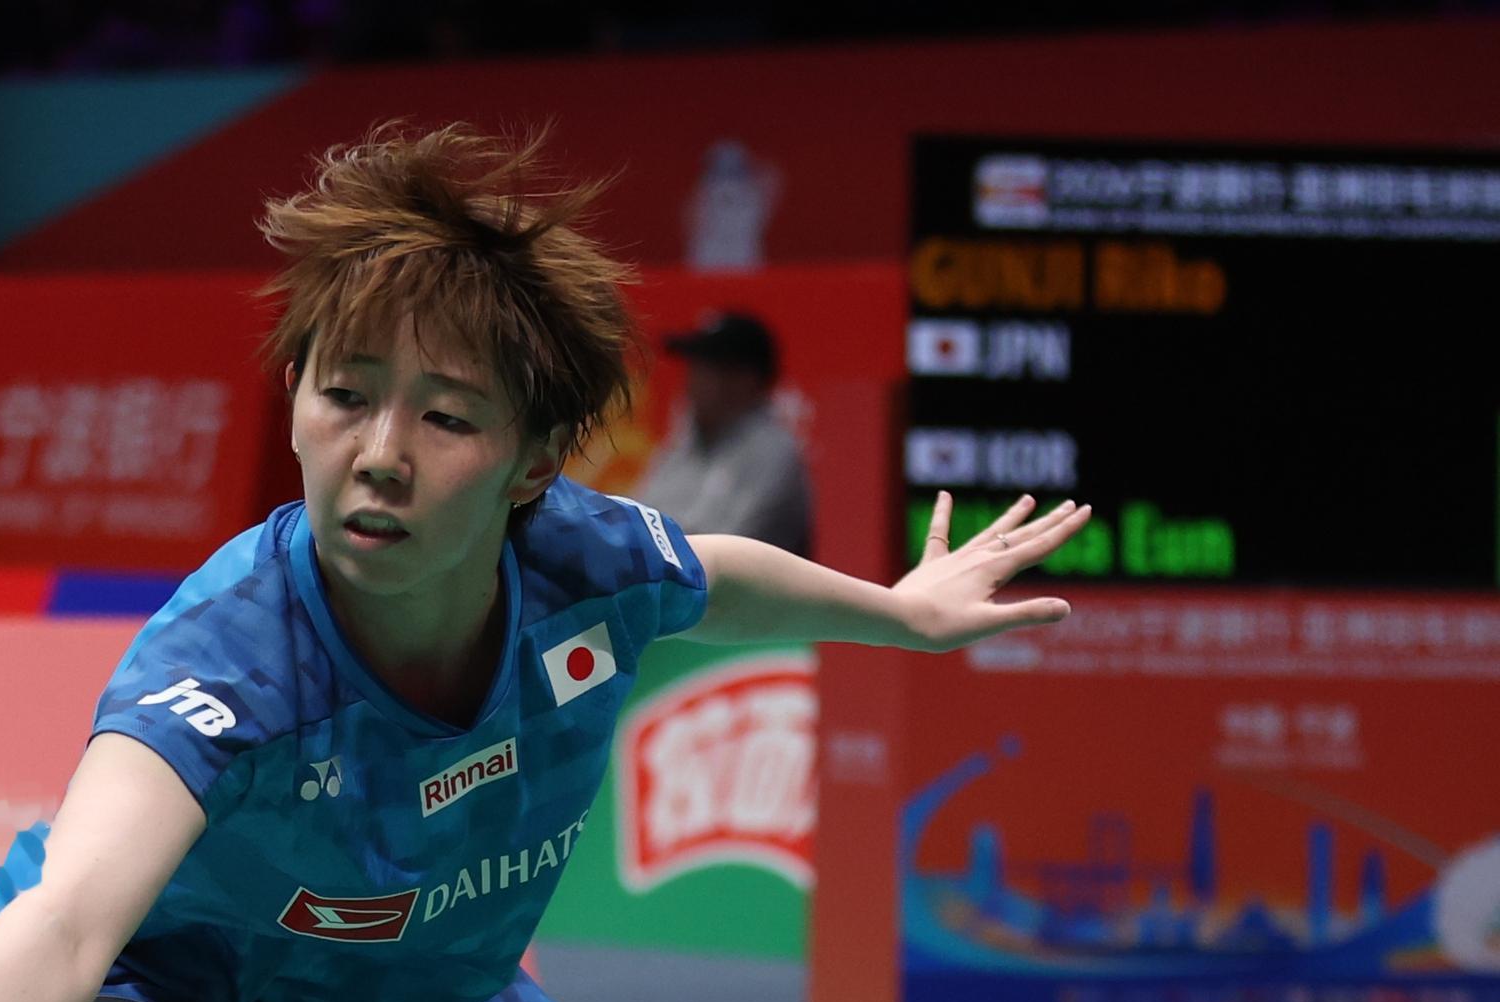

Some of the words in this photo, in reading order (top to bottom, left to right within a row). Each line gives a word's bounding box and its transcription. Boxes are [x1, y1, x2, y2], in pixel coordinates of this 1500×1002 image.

[986, 322, 1070, 380] JPN
[136, 677, 236, 737] JTB
[424, 743, 514, 811] Rinnai
